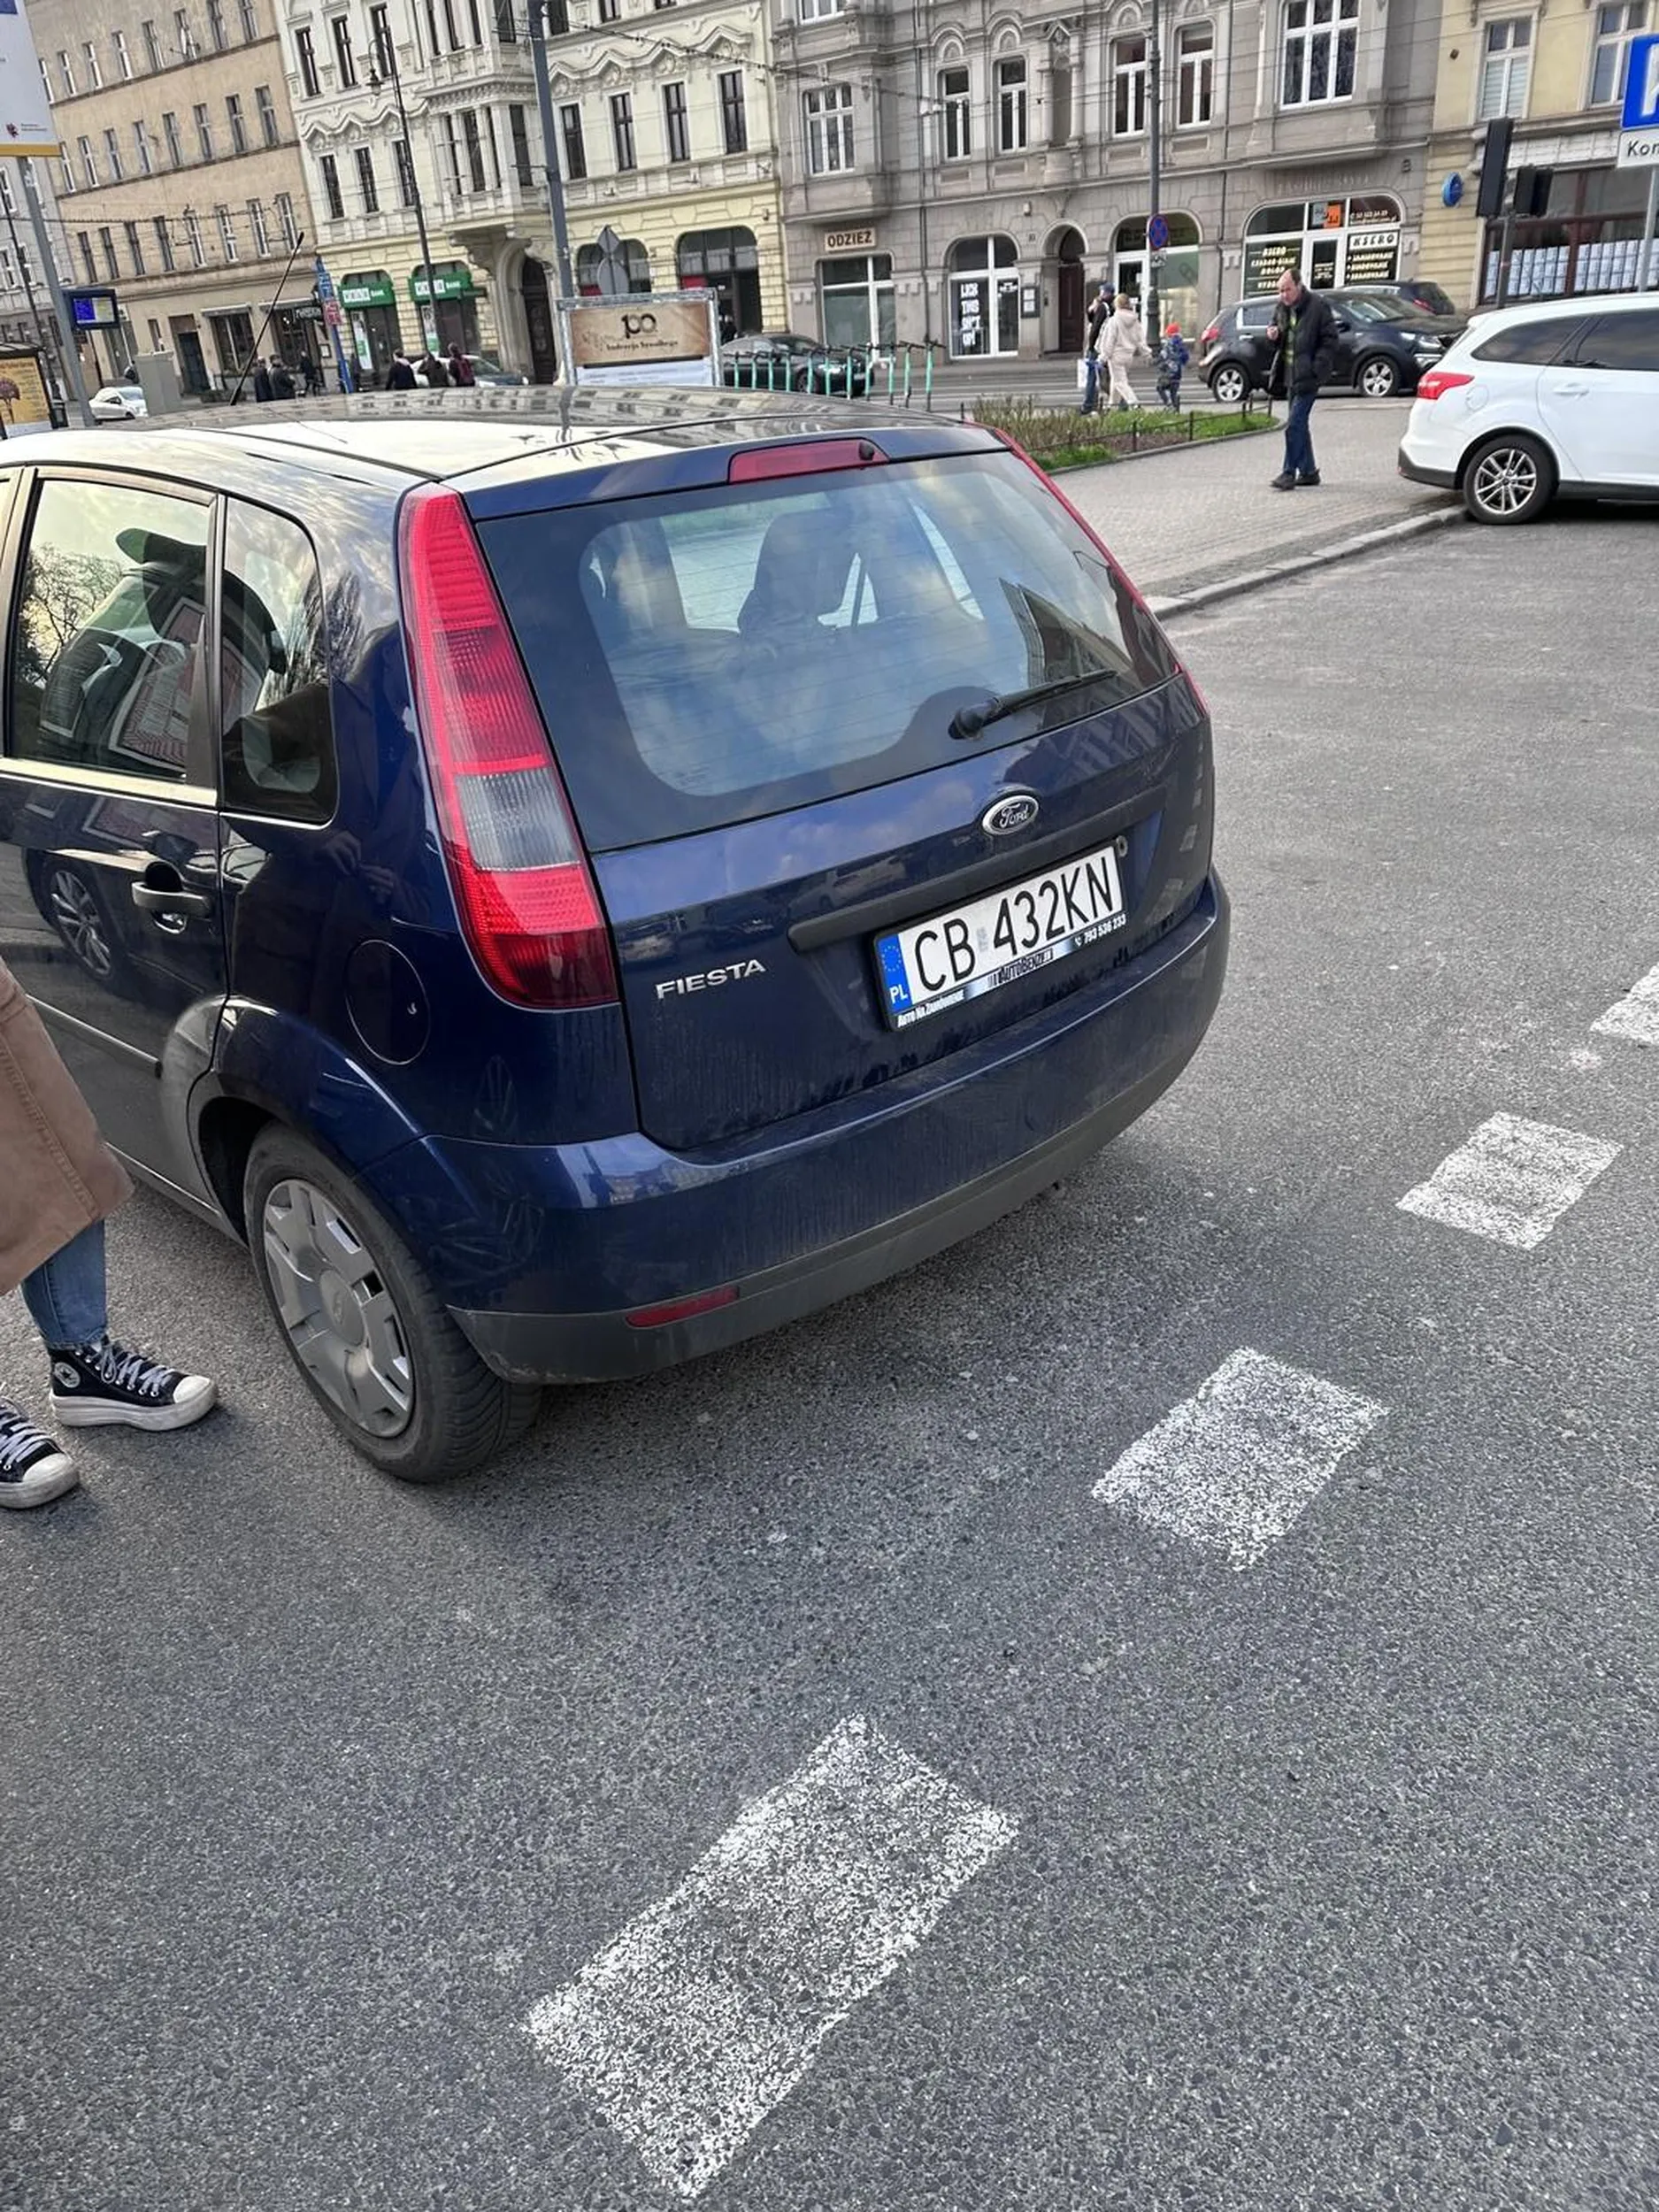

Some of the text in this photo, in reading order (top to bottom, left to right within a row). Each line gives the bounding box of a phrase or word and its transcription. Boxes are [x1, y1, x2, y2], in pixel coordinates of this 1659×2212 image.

[1353, 234, 1394, 246] KSERO
[999, 803, 1029, 828] Ford
[914, 856, 1114, 992] CB 432KN
[656, 959, 766, 999] FIESTA
[889, 984, 908, 1004] PL
